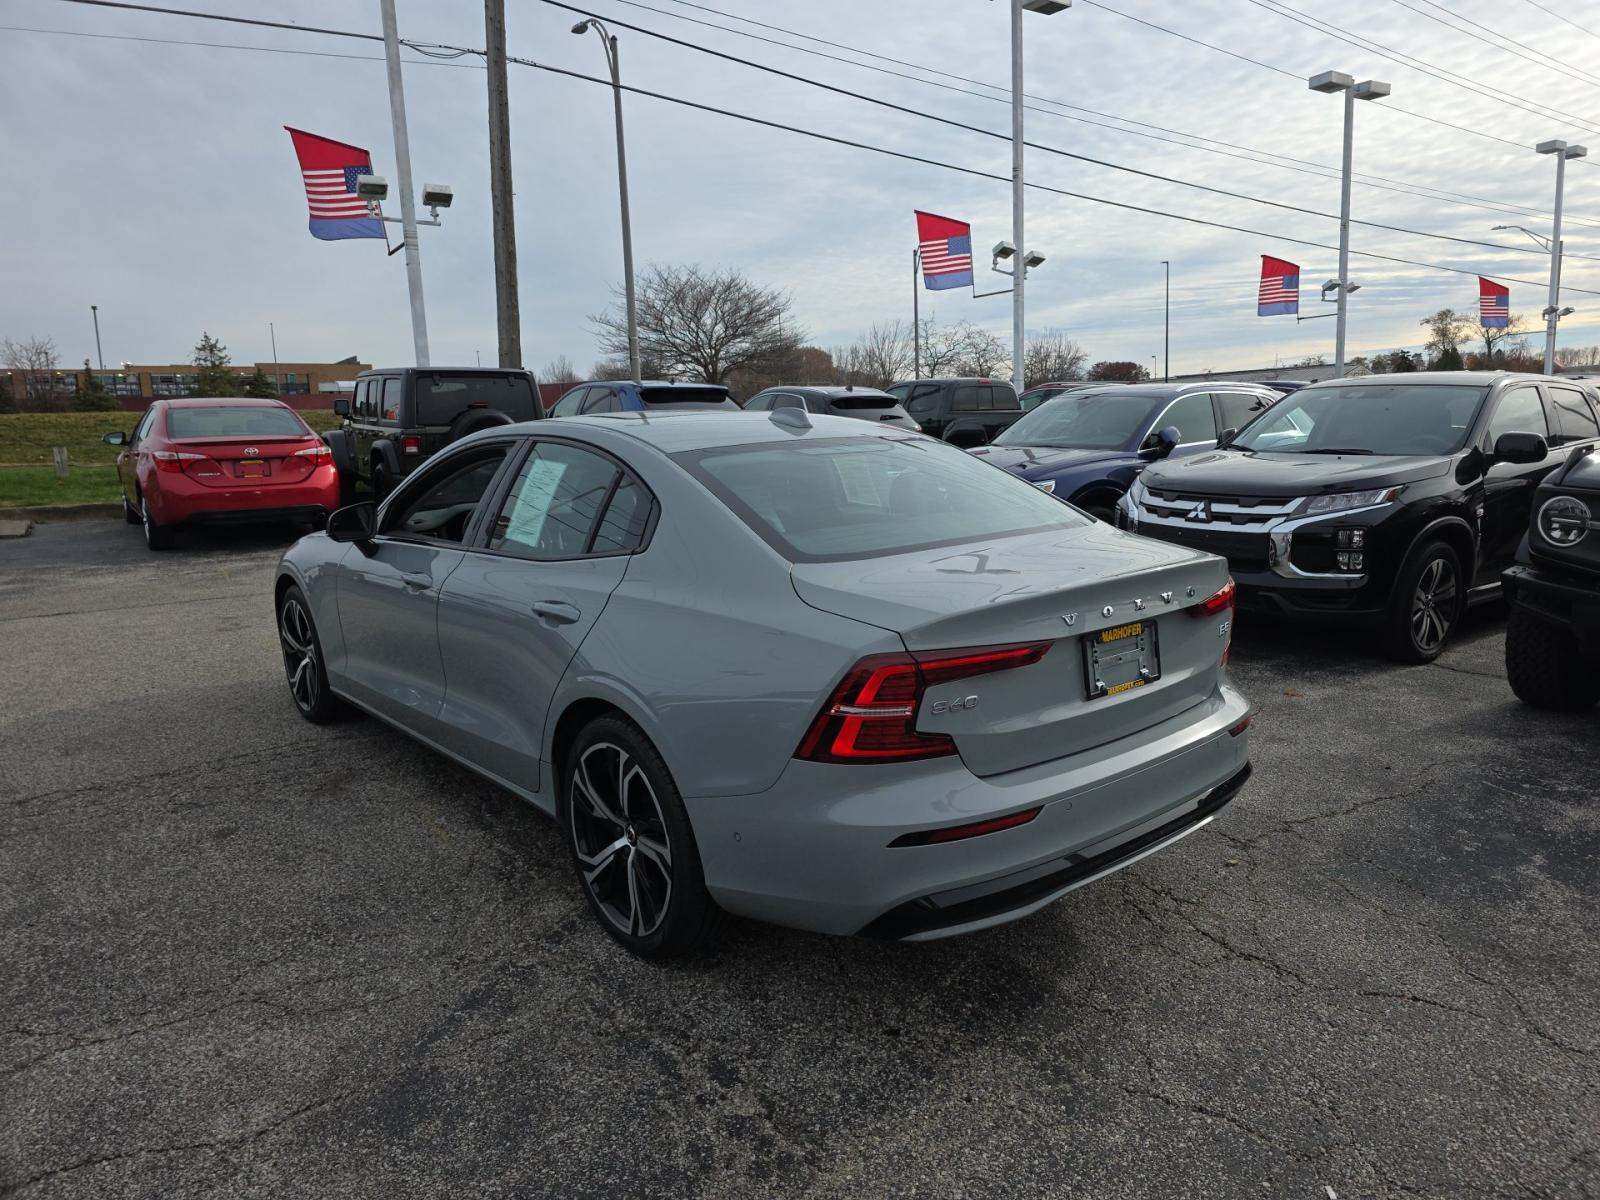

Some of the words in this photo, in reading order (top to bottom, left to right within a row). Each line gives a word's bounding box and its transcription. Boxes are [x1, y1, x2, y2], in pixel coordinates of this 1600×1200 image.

[1061, 586, 1196, 626] VOLVO
[1102, 623, 1142, 642] MARHOFER
[932, 695, 978, 714] S60
